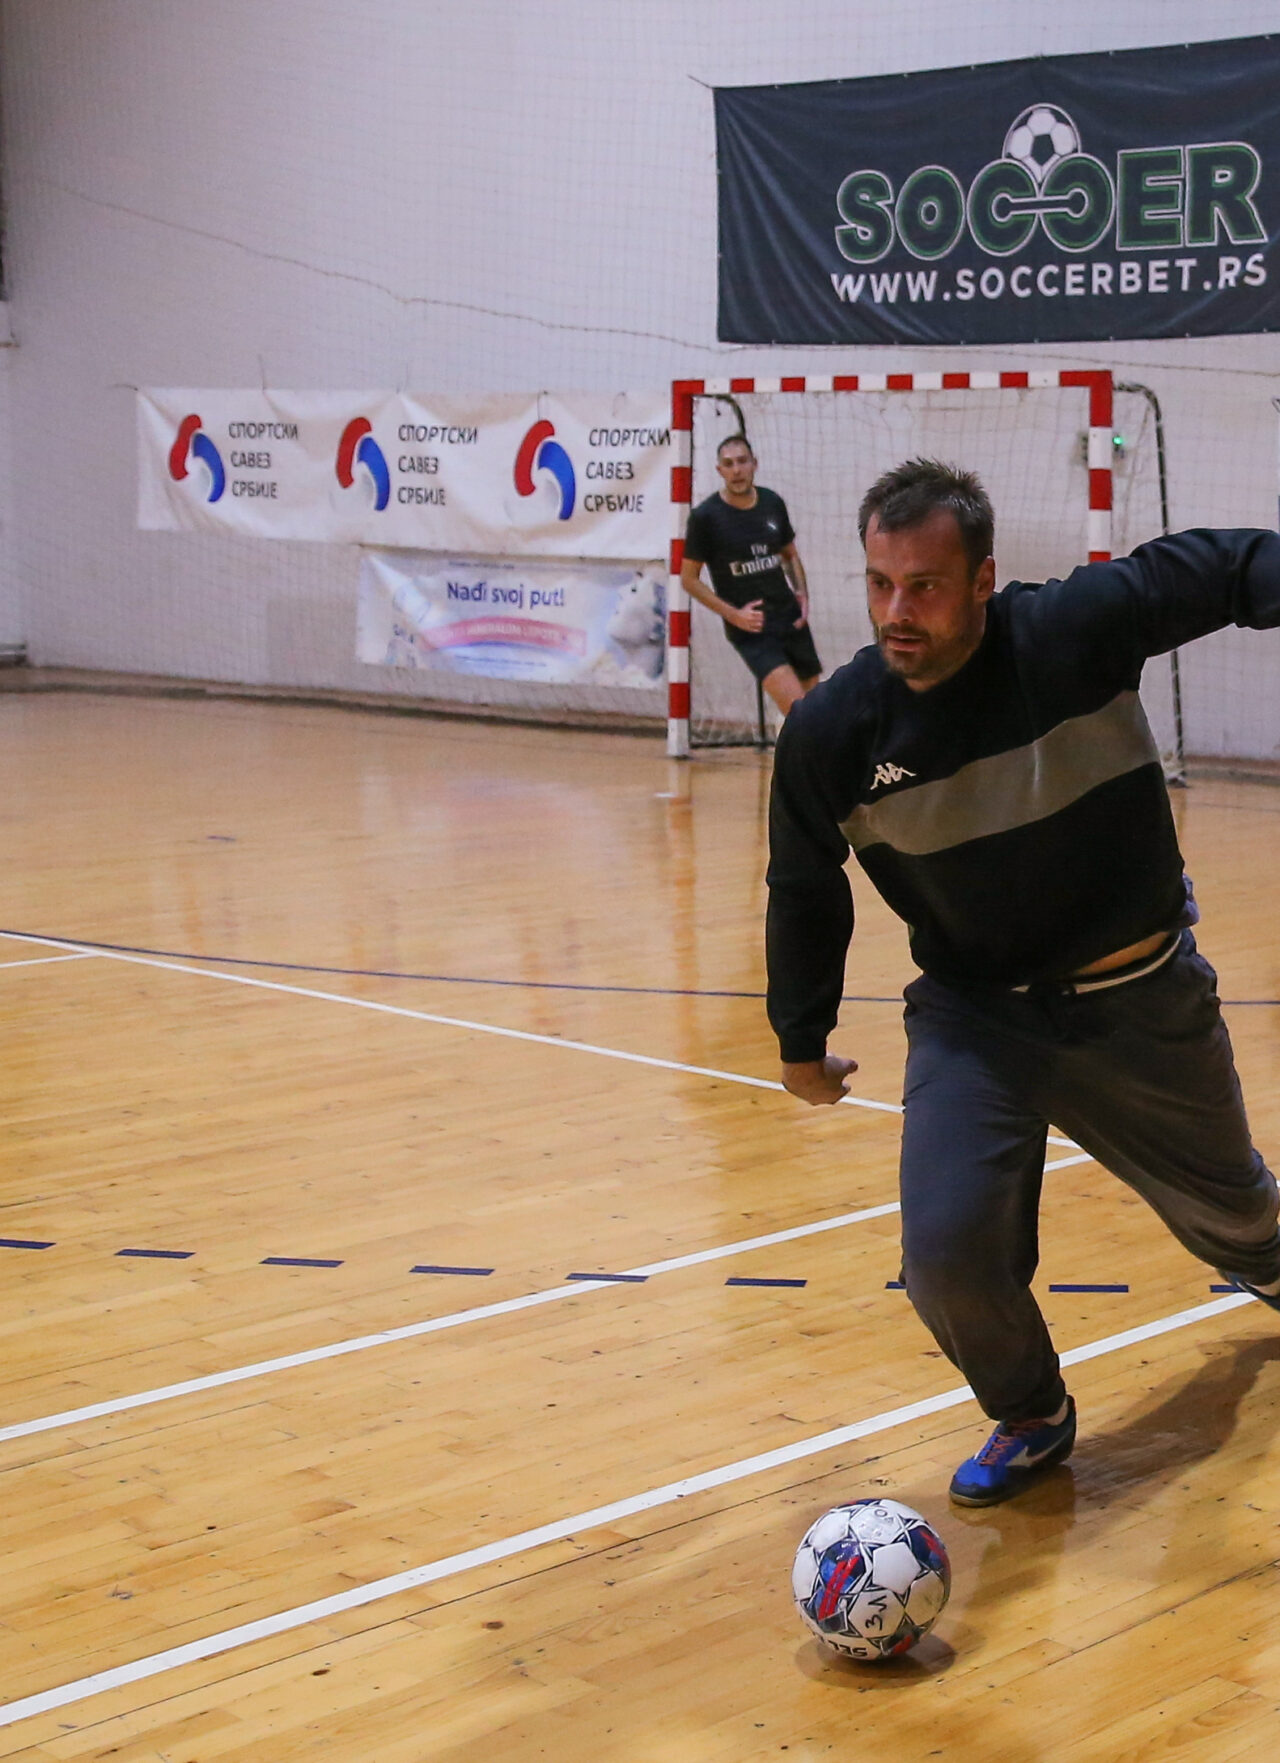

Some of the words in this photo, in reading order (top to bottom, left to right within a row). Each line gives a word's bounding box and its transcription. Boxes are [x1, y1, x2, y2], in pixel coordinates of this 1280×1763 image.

[834, 141, 1269, 265] SOCCER
[830, 252, 1268, 304] WWW.SOCCERBET.RS
[228, 422, 298, 440] СПОРТСКИ
[398, 424, 478, 444] СПОРТСКИ
[588, 428, 671, 447] СПОРТСКИ
[230, 451, 271, 468] САВЕЗ
[398, 455, 438, 474] САВЕЗ
[586, 461, 634, 480] САВЕЗ
[232, 480, 277, 498] СРБИЈЕ
[397, 486, 445, 506] СРБИЈЕ
[583, 494, 644, 513] СРБИЈЕ
[491, 584, 525, 609] svoj
[530, 588, 565, 609] put!
